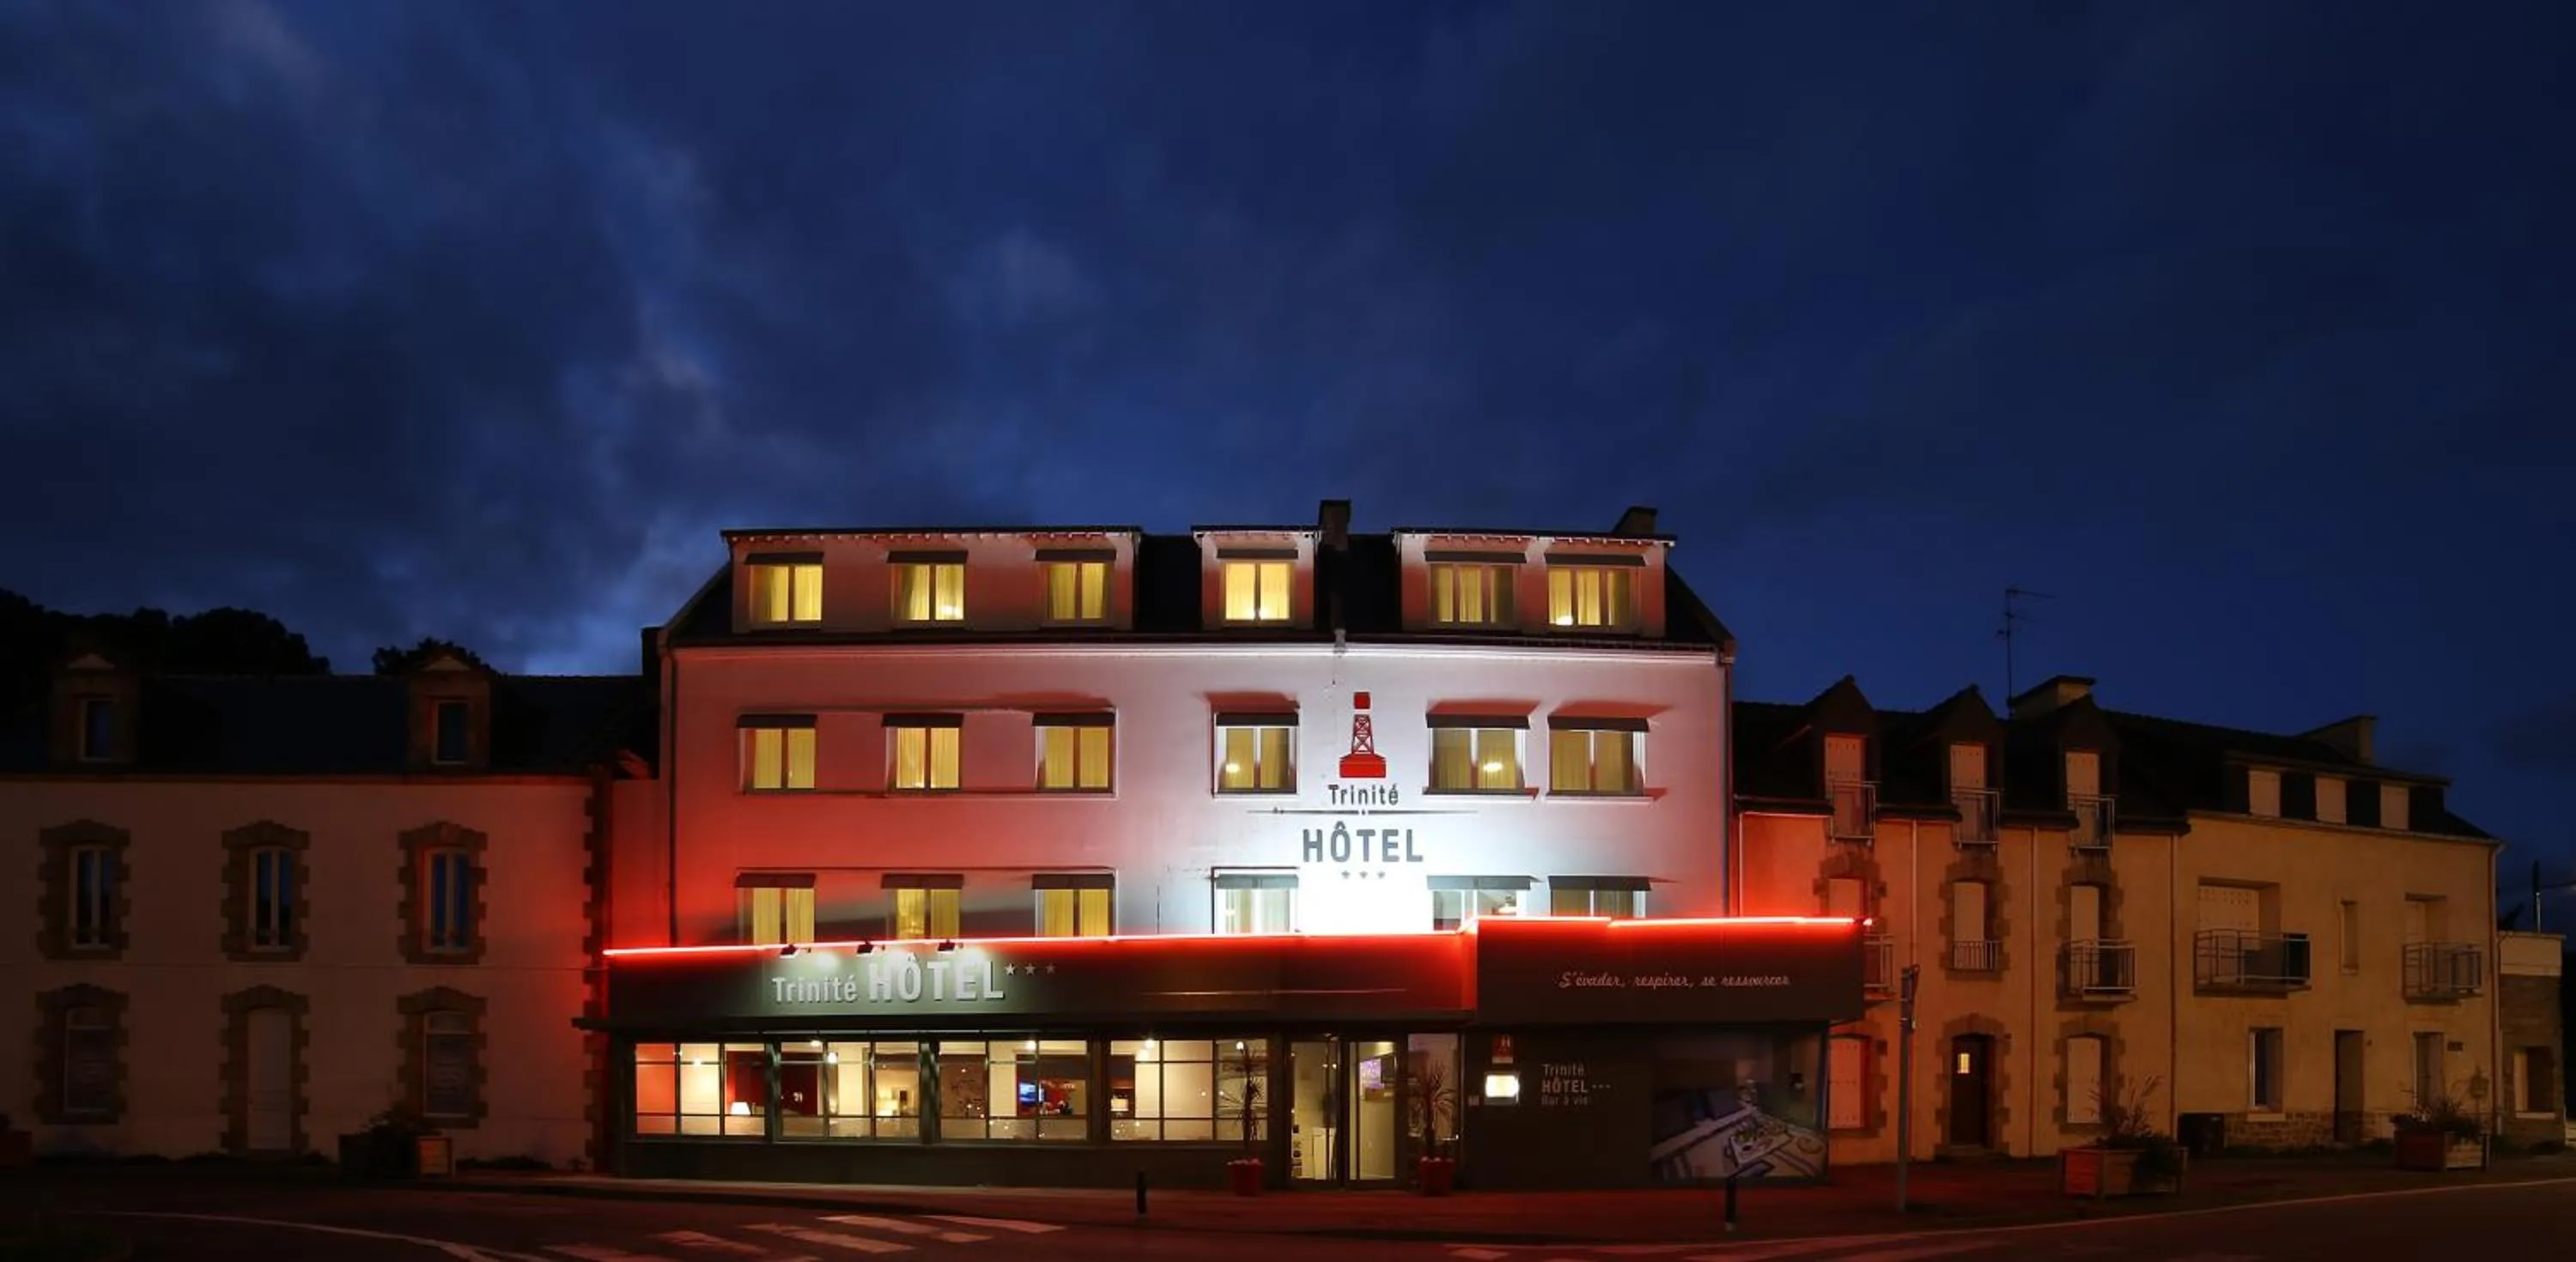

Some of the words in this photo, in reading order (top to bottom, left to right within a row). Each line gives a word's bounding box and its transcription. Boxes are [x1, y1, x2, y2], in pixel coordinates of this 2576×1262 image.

[1327, 783, 1399, 805] Trinité
[1303, 821, 1424, 862] HÔTEL
[772, 975, 858, 1002] Trinité
[868, 952, 1004, 1002] HÔTEL
[1700, 975, 1717, 986] se
[1541, 1063, 1585, 1077] Trinité
[1541, 1077, 1588, 1093] HÔTEL
